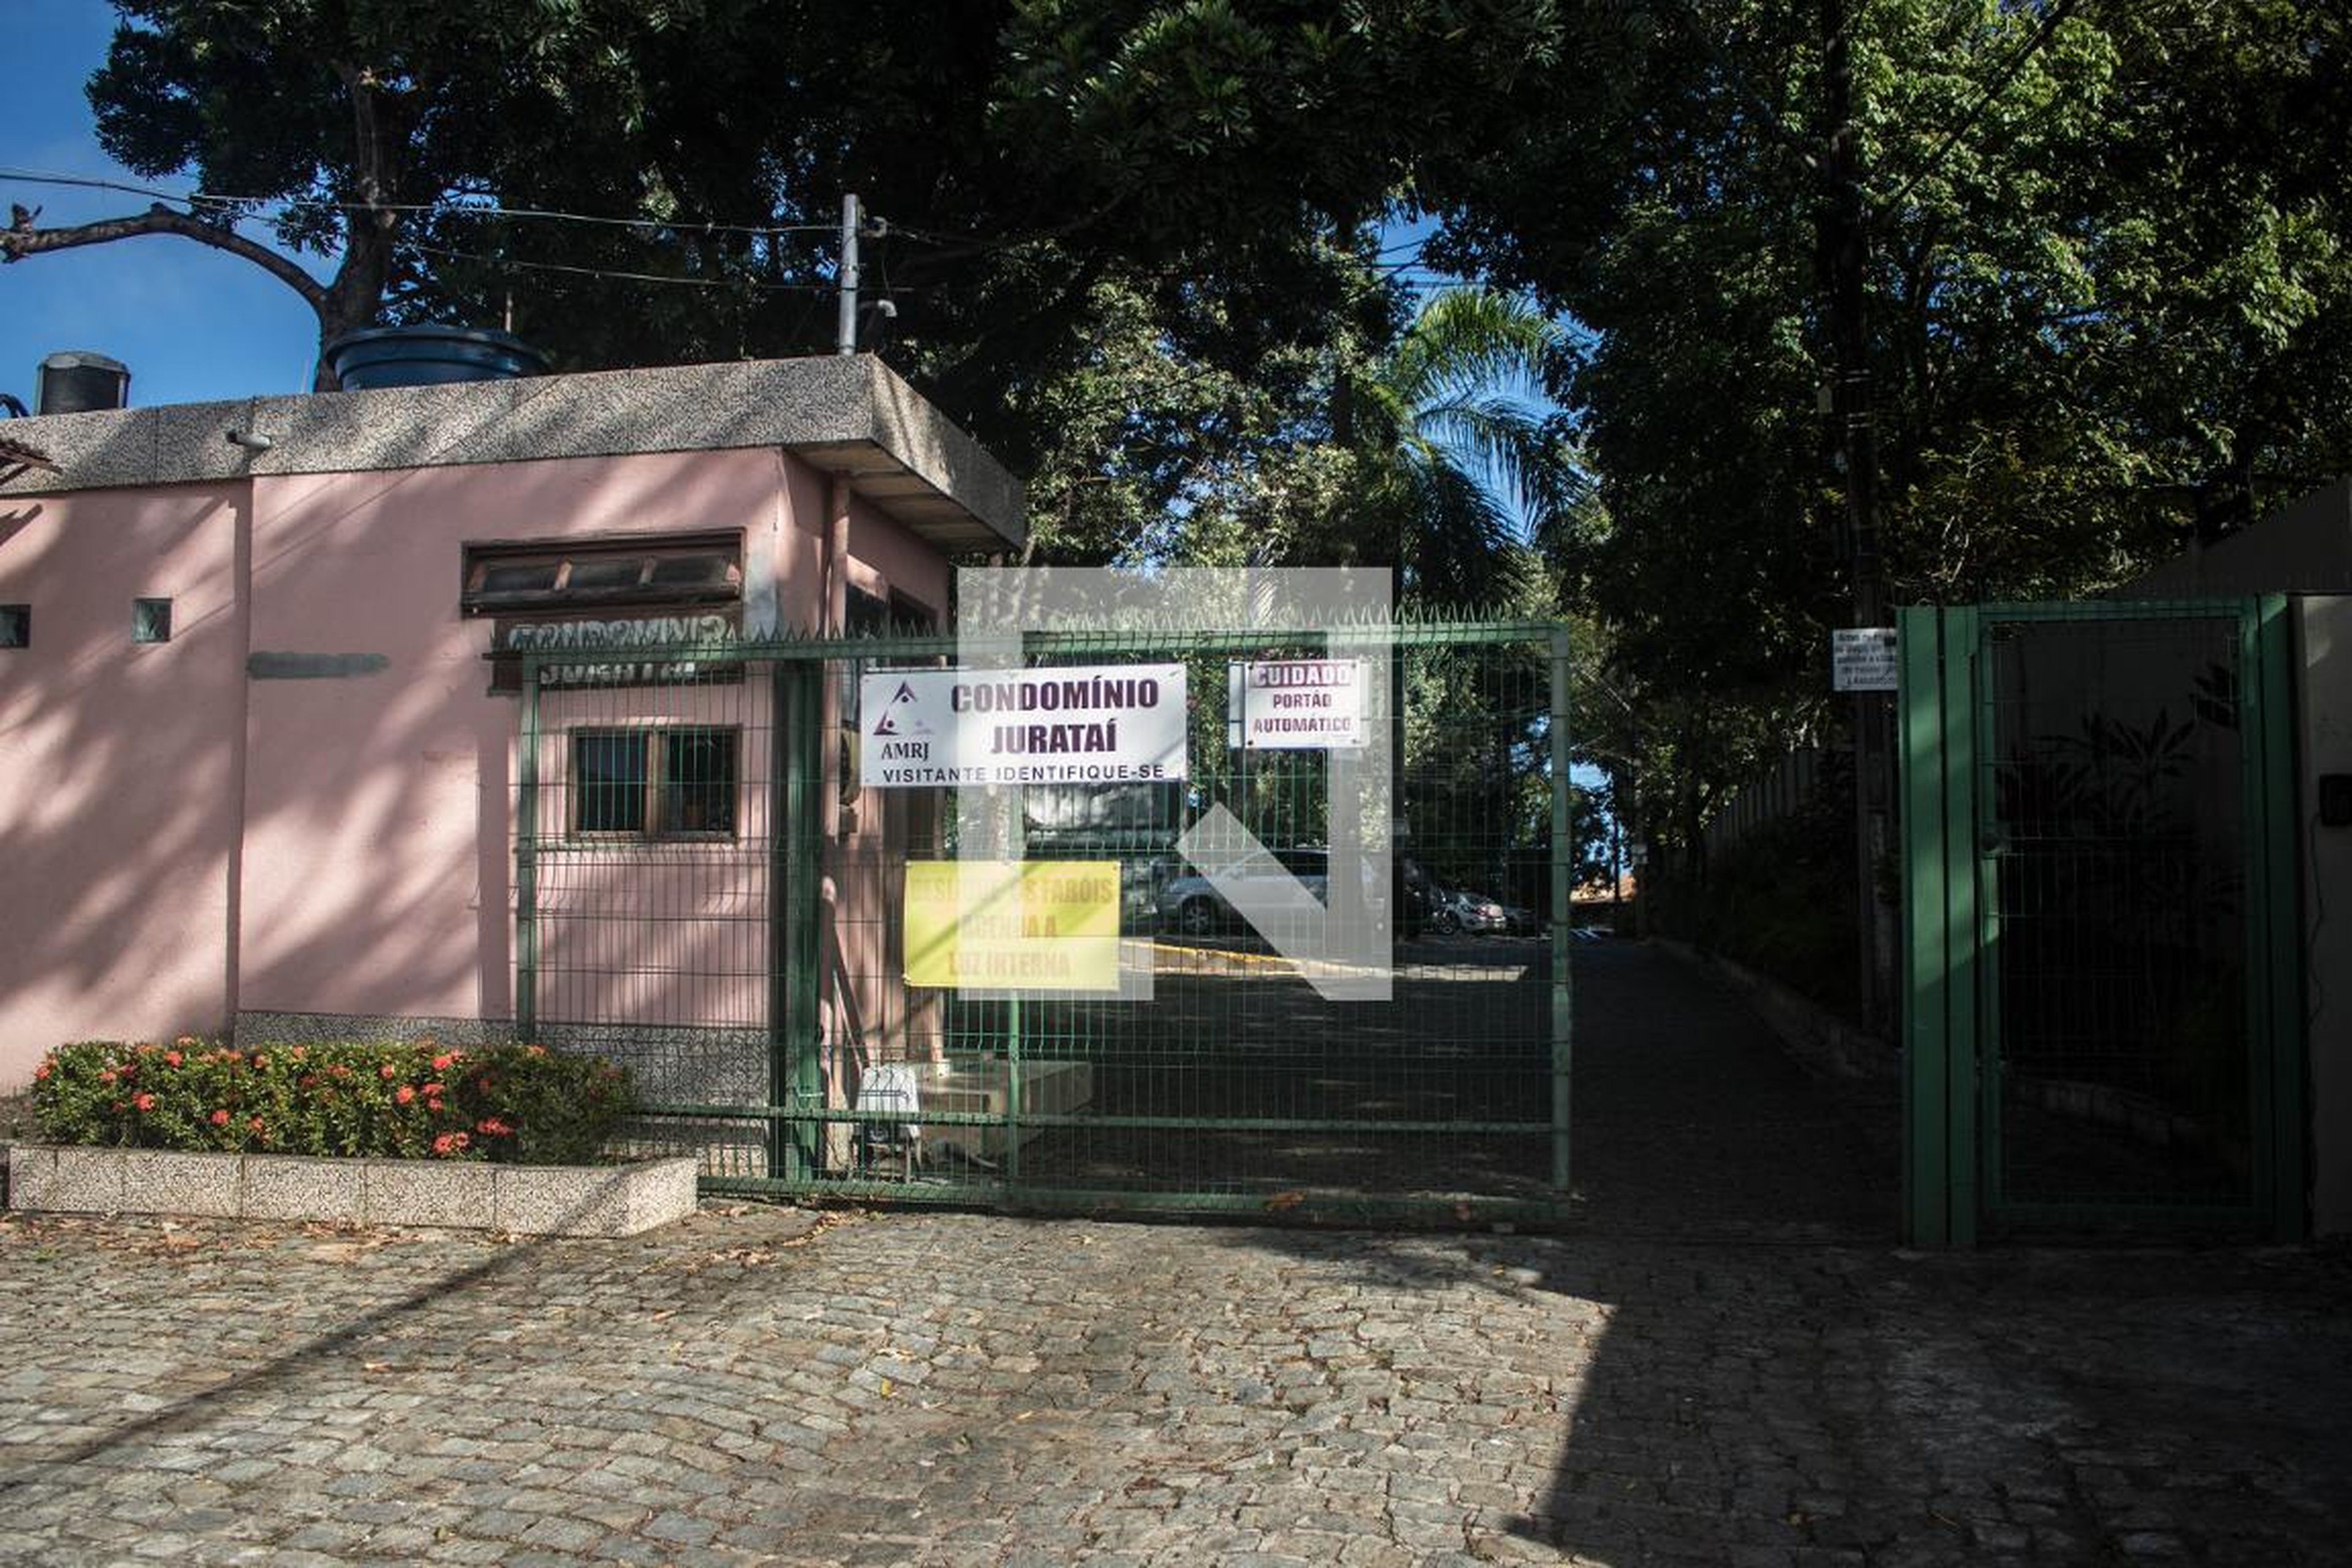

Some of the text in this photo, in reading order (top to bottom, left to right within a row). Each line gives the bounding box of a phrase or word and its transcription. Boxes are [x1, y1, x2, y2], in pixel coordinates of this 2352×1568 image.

[1256, 666, 1351, 687] CUIDADO
[951, 675, 1159, 713] CONDOMÍNIO
[1273, 689, 1332, 709] PORTÃO
[1255, 713, 1351, 733] AUTOMÁTICO
[990, 717, 1117, 755] JURATAÍ
[881, 742, 930, 761] AMRJ
[883, 764, 1164, 783] VISITANTE IDENTIFIQUE-SE
